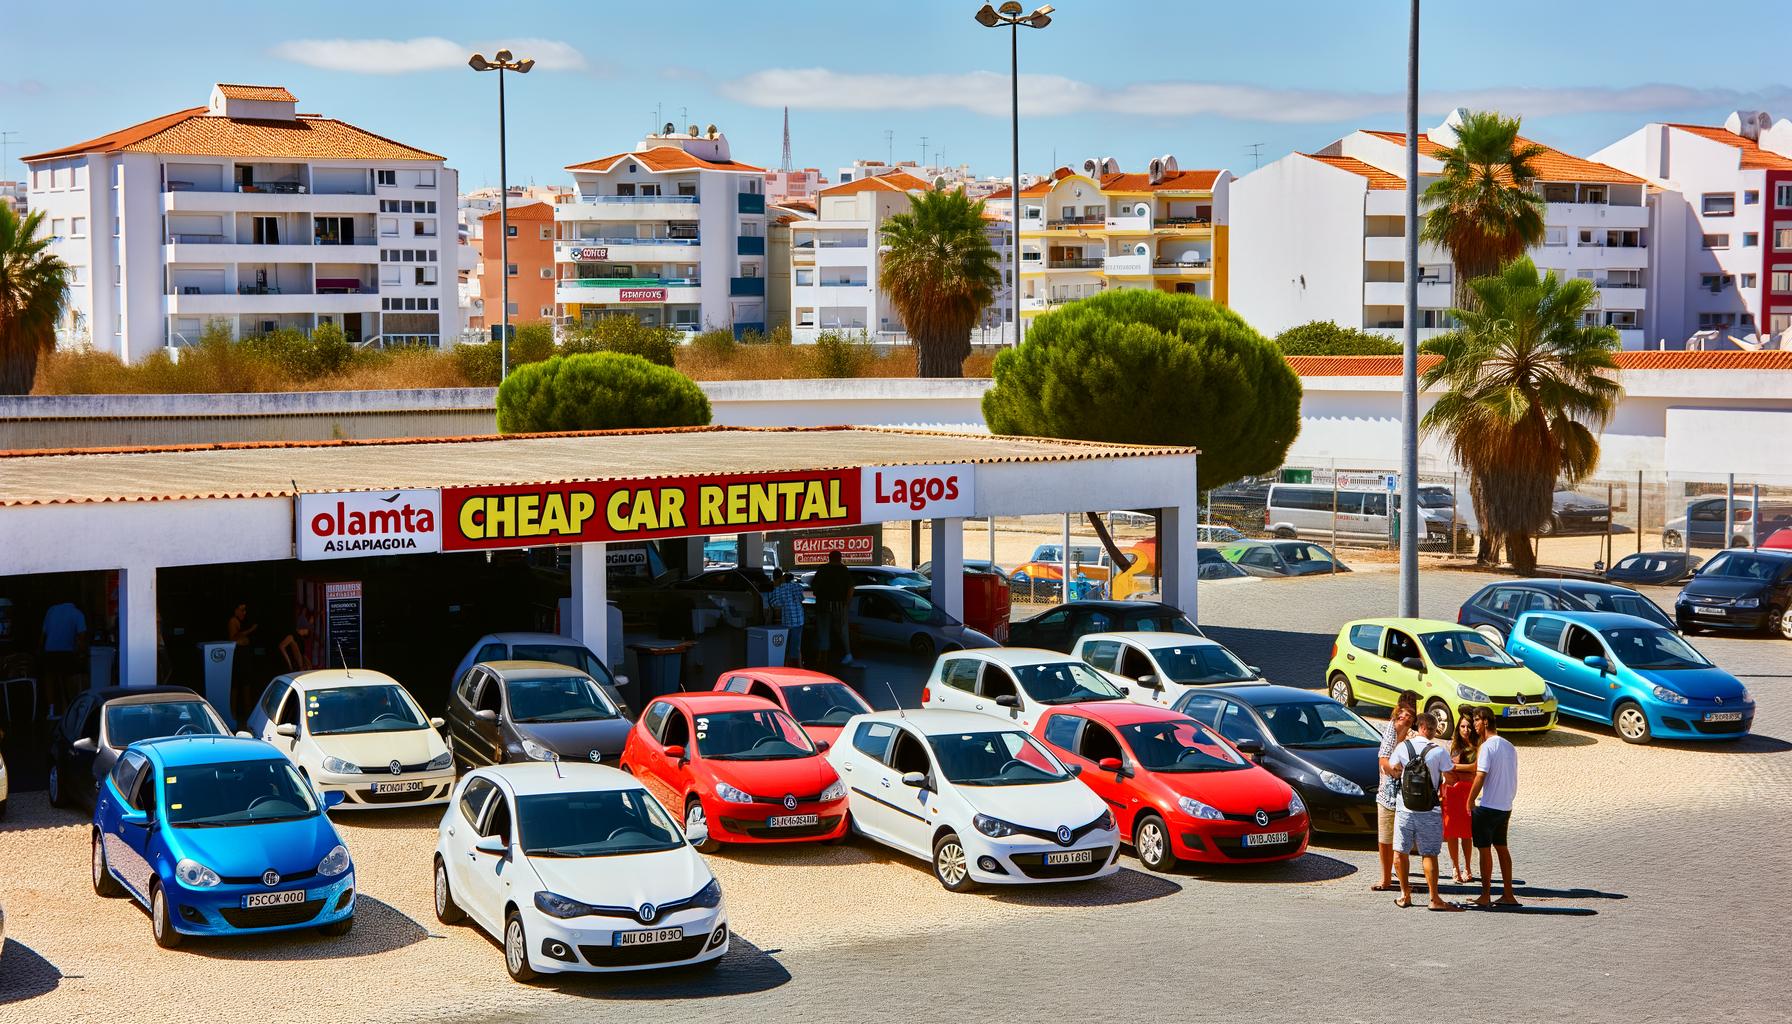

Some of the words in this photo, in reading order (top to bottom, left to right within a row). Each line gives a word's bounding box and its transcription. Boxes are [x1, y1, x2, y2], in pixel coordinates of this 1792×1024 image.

[458, 493, 596, 540] CHEAP
[605, 487, 686, 532] CAR
[699, 479, 848, 526] RENTAL
[875, 472, 959, 511] Lagos
[311, 502, 435, 537] olamta
